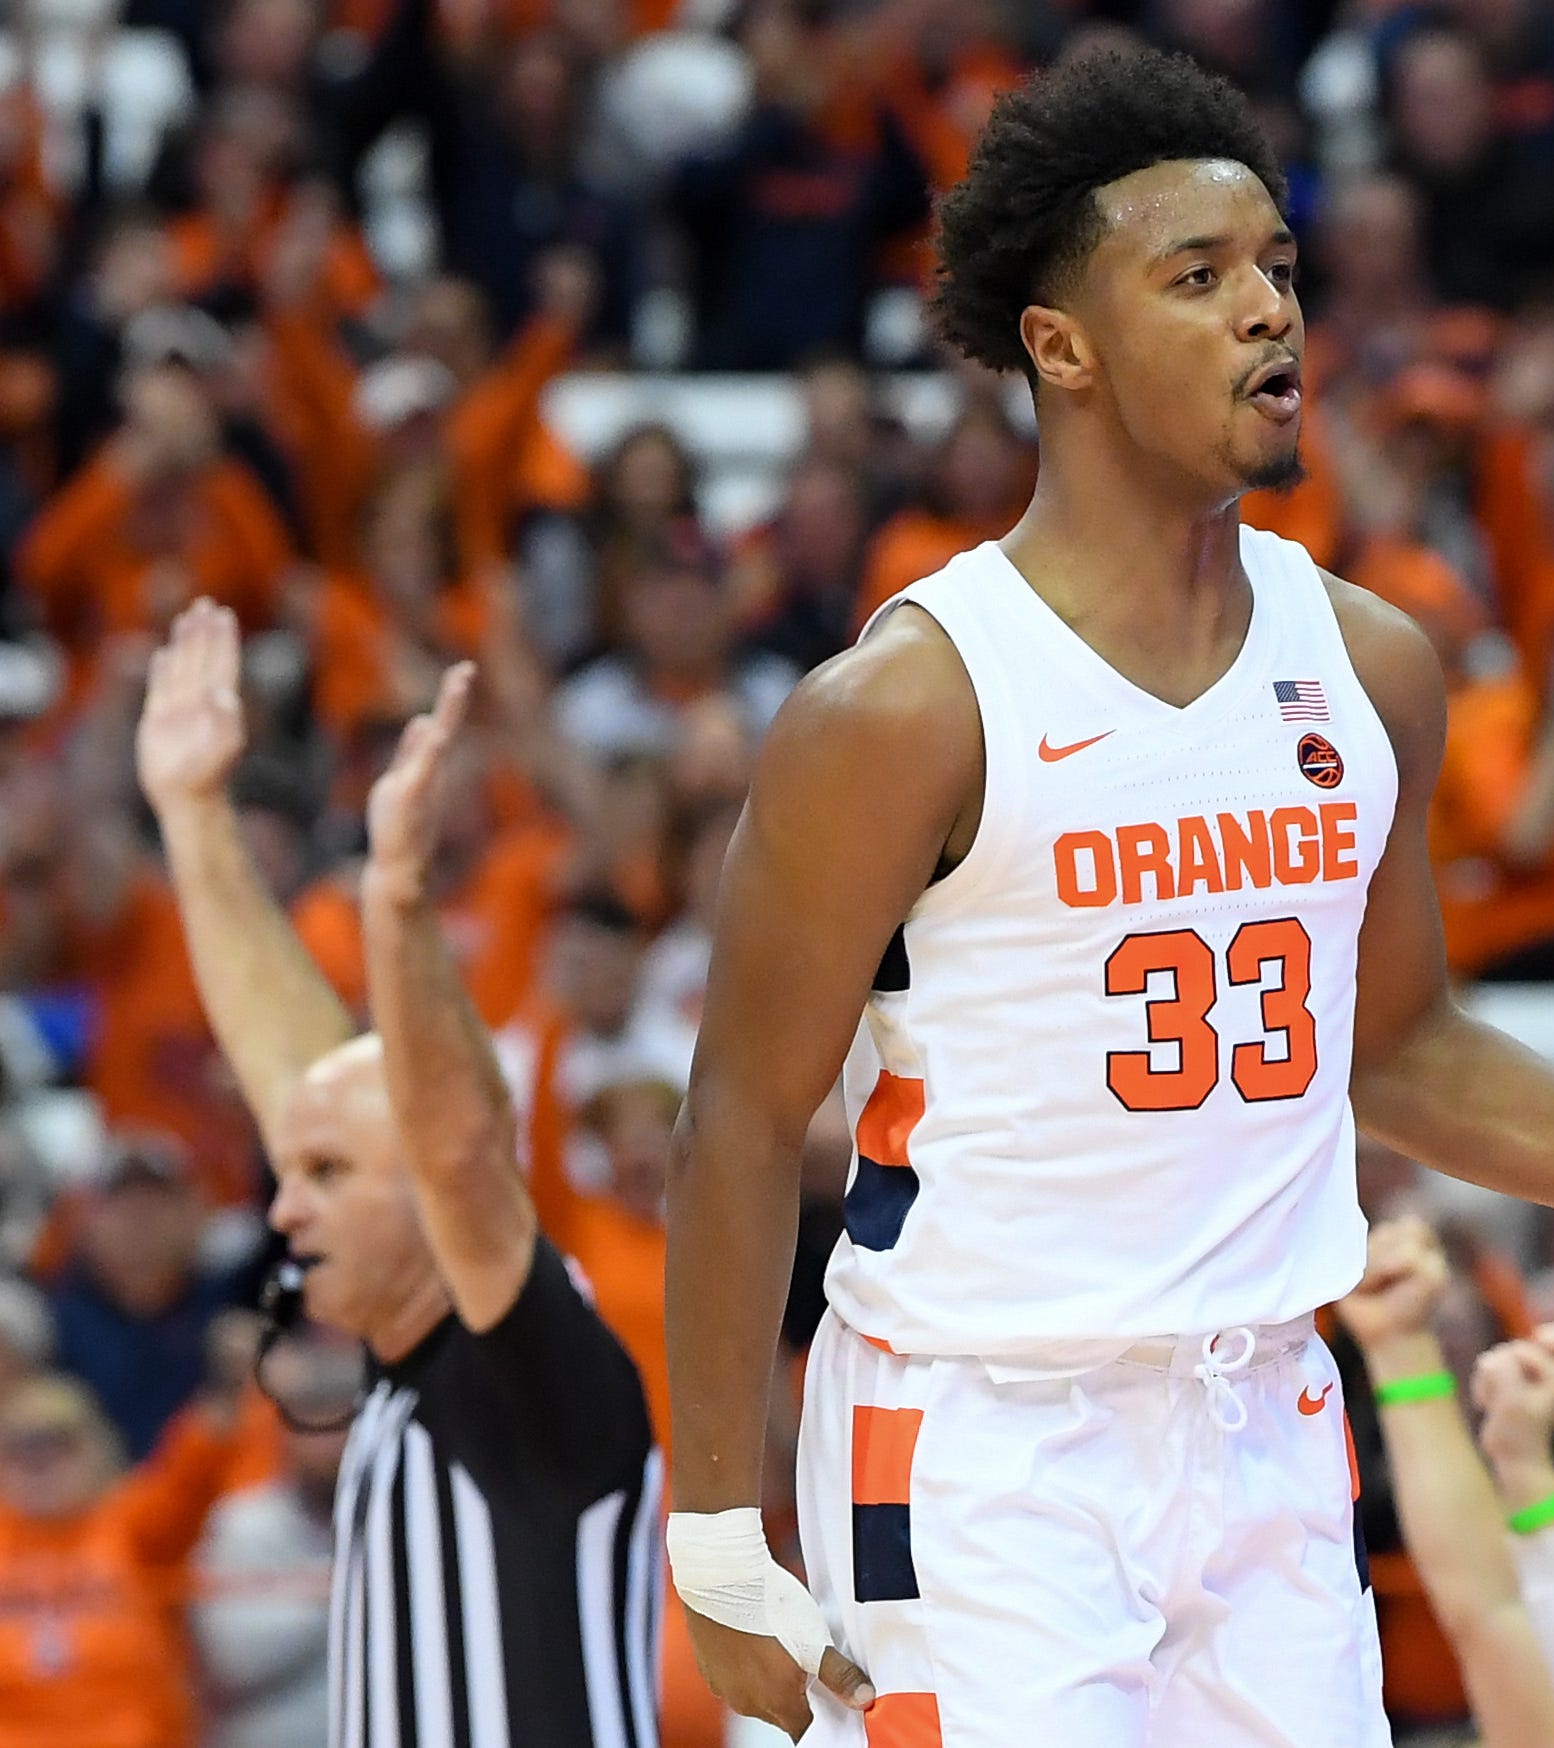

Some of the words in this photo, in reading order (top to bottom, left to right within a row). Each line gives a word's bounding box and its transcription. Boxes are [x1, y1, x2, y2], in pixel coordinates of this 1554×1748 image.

[1305, 751, 1337, 763] ACC
[1053, 802, 1358, 908] ORANGE
[1104, 917, 1317, 1112] 33
